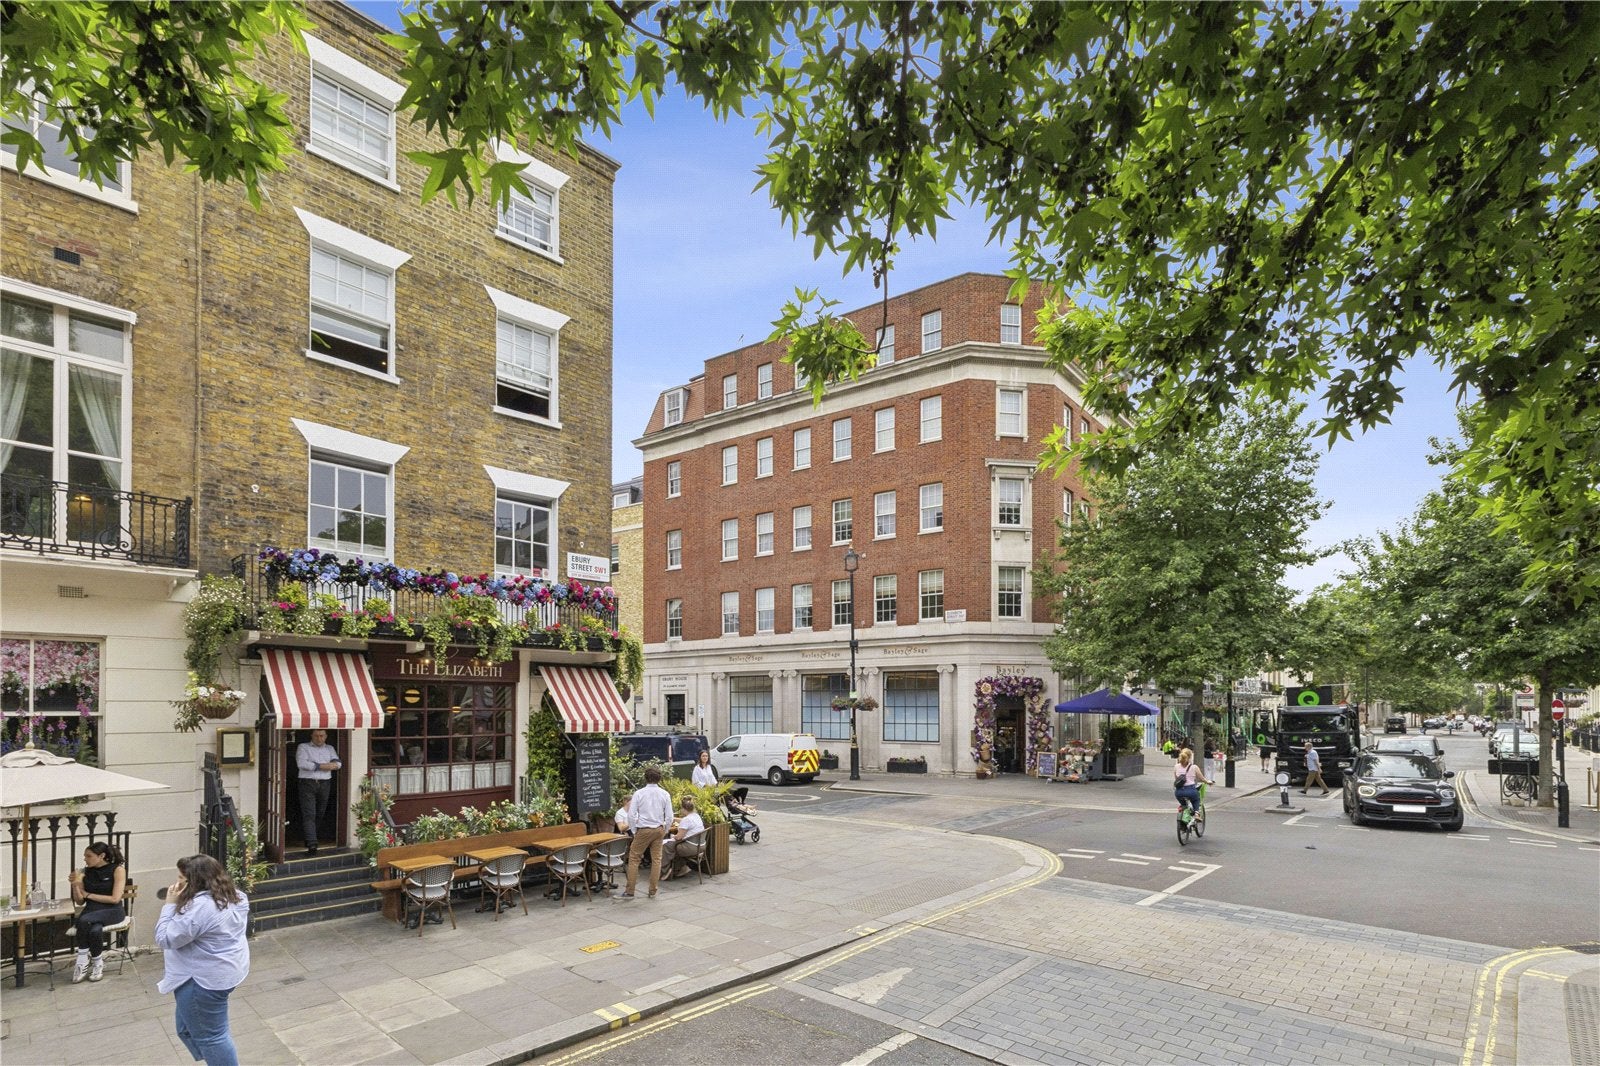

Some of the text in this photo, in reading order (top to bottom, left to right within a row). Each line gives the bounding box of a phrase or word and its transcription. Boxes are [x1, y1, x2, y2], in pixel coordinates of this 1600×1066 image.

[571, 556, 590, 564] EBURY
[571, 564, 592, 572] STREET
[396, 658, 430, 675] THE
[996, 665, 1026, 675] Bayley
